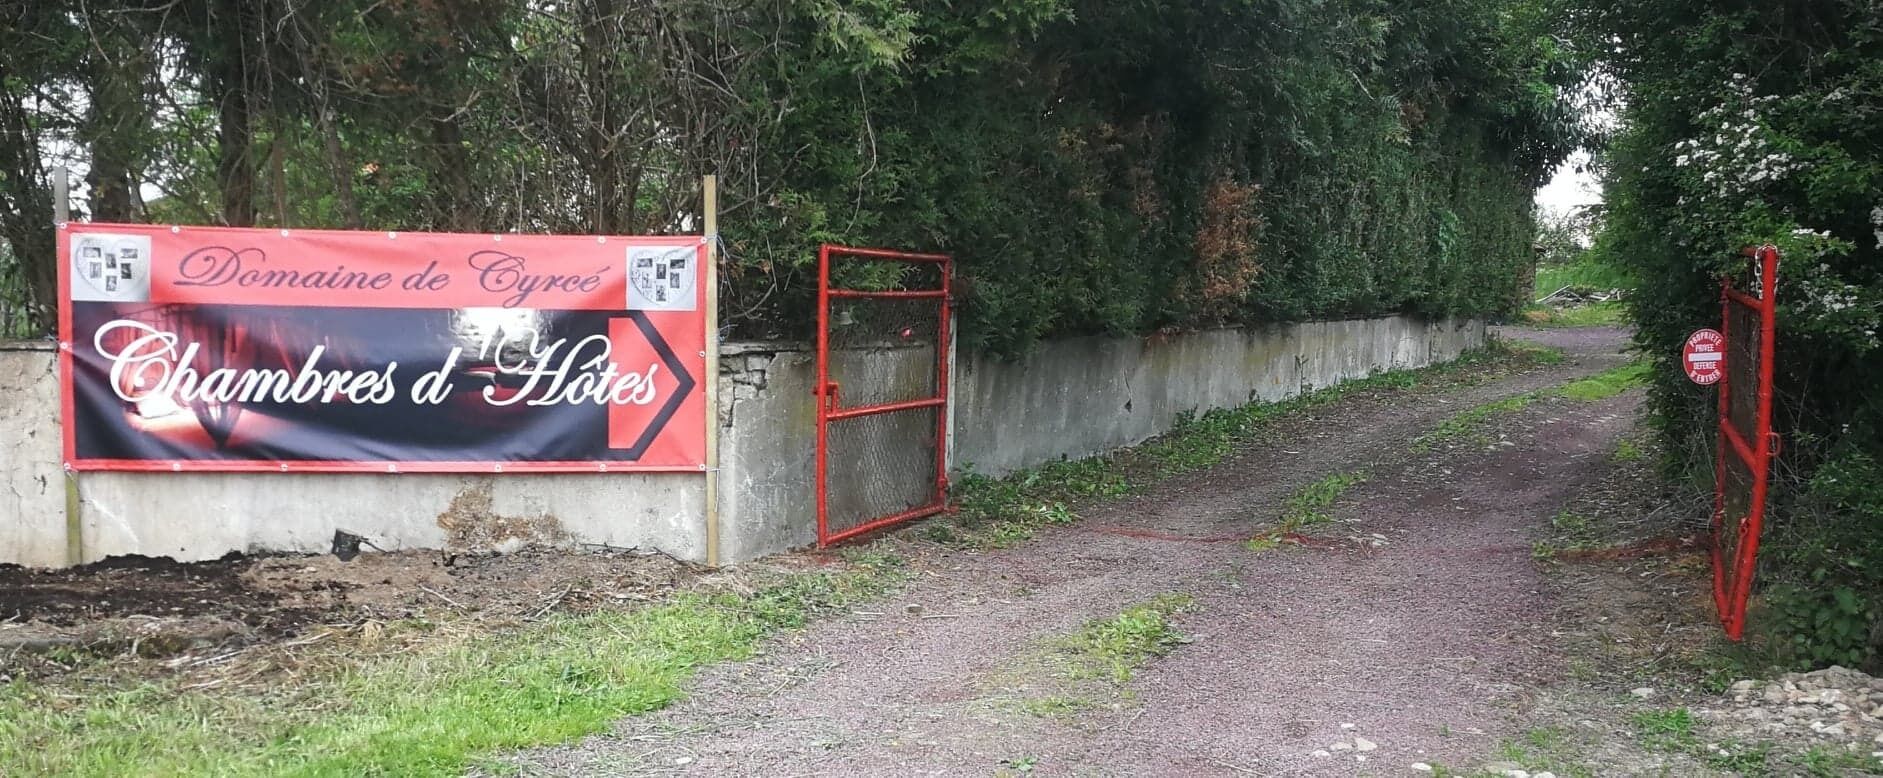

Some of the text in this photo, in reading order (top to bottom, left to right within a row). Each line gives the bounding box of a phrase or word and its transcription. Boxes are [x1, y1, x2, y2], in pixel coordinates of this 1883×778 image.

[173, 246, 610, 309] Domaine de Cyrcé
[94, 319, 398, 405] Chambres
